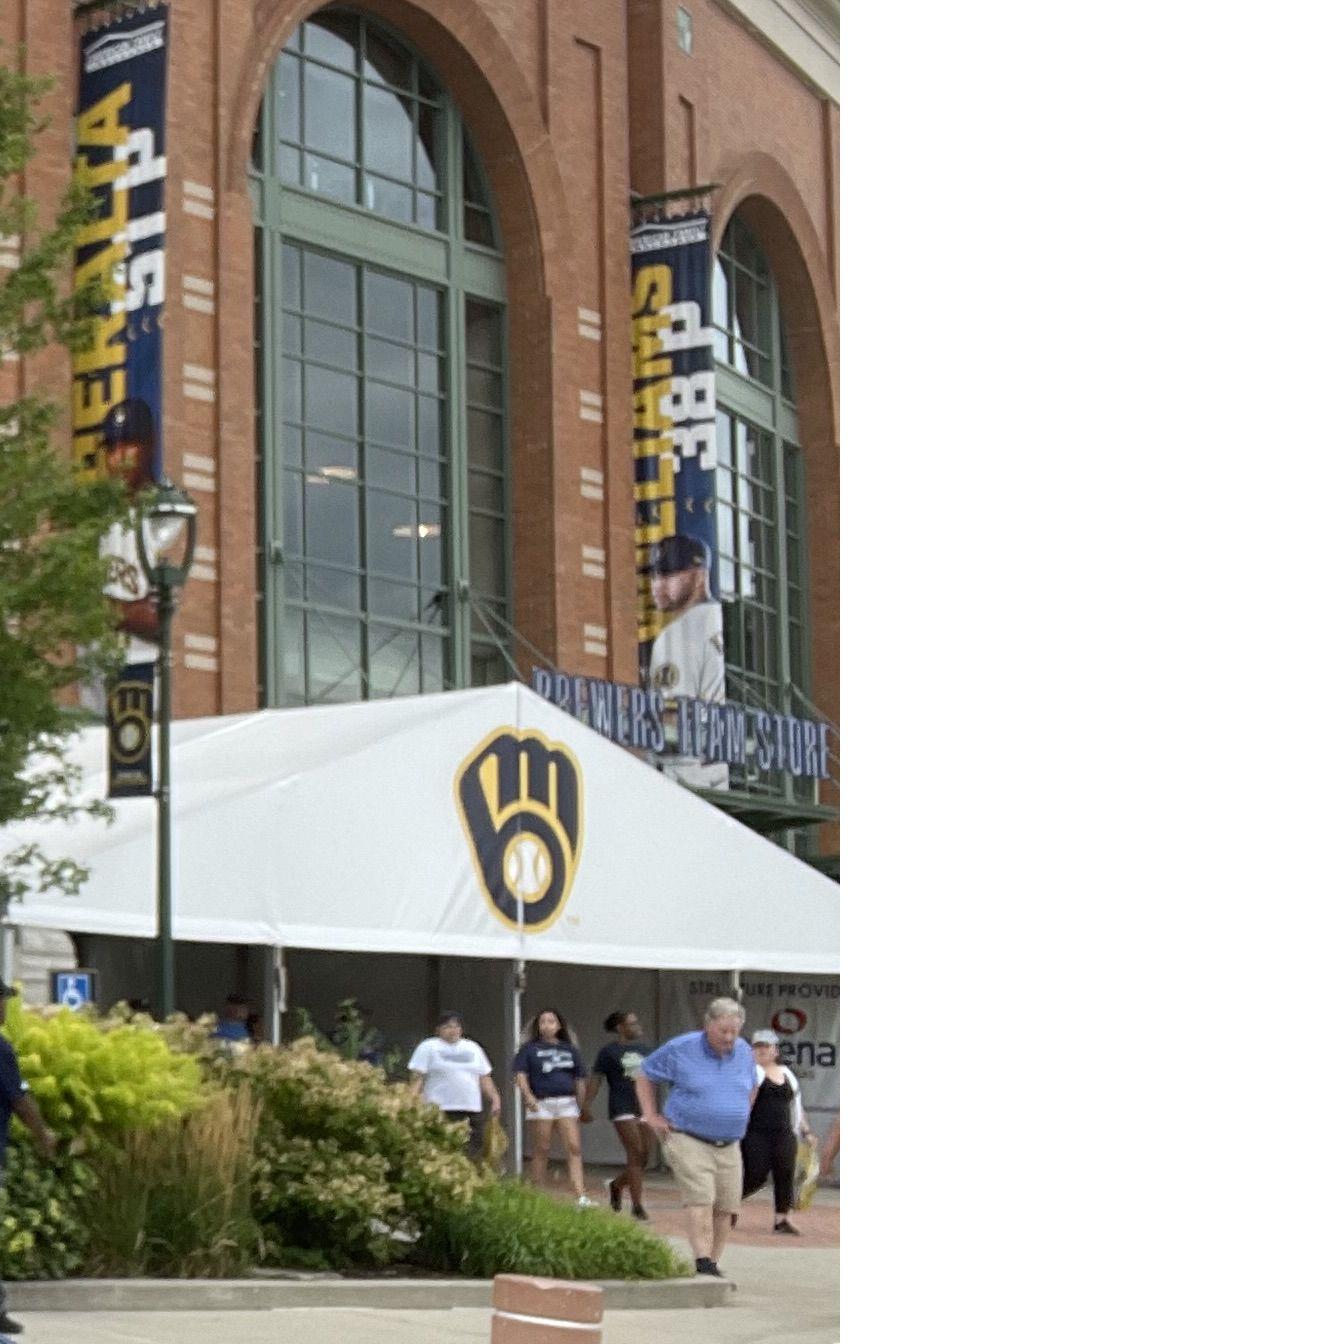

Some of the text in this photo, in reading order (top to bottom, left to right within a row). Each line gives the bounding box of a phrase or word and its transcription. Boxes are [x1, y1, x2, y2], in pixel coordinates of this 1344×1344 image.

[656, 301, 716, 352] P
[659, 370, 717, 474] 38
[678, 695, 747, 765] TEAM
[755, 709, 831, 779] STORE
